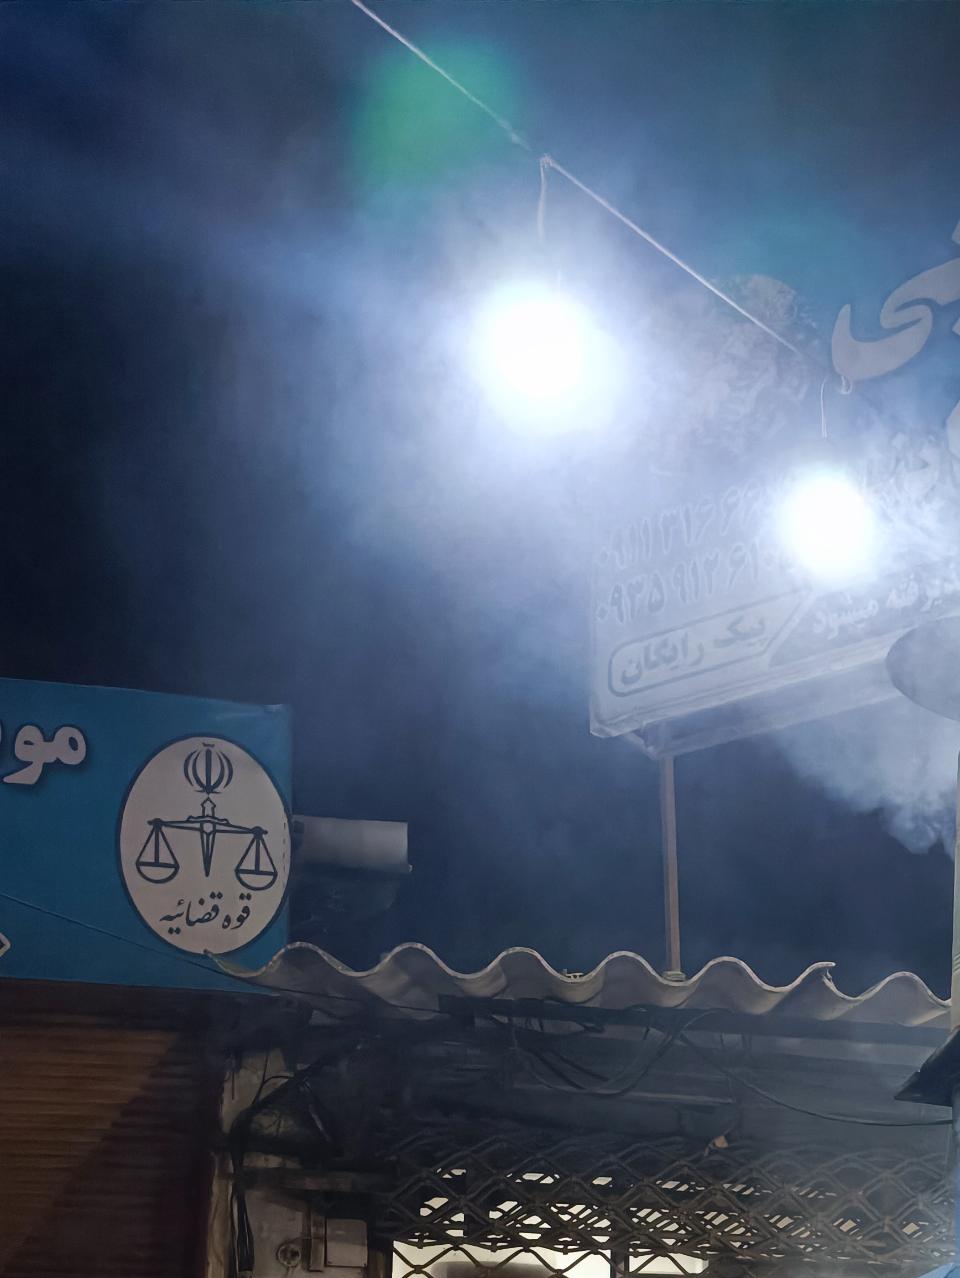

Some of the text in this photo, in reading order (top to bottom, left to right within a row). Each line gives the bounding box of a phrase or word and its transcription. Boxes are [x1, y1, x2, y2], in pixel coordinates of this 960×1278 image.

[620, 615, 767, 686] پیک رایگان
[221, 891, 253, 932] قوه
